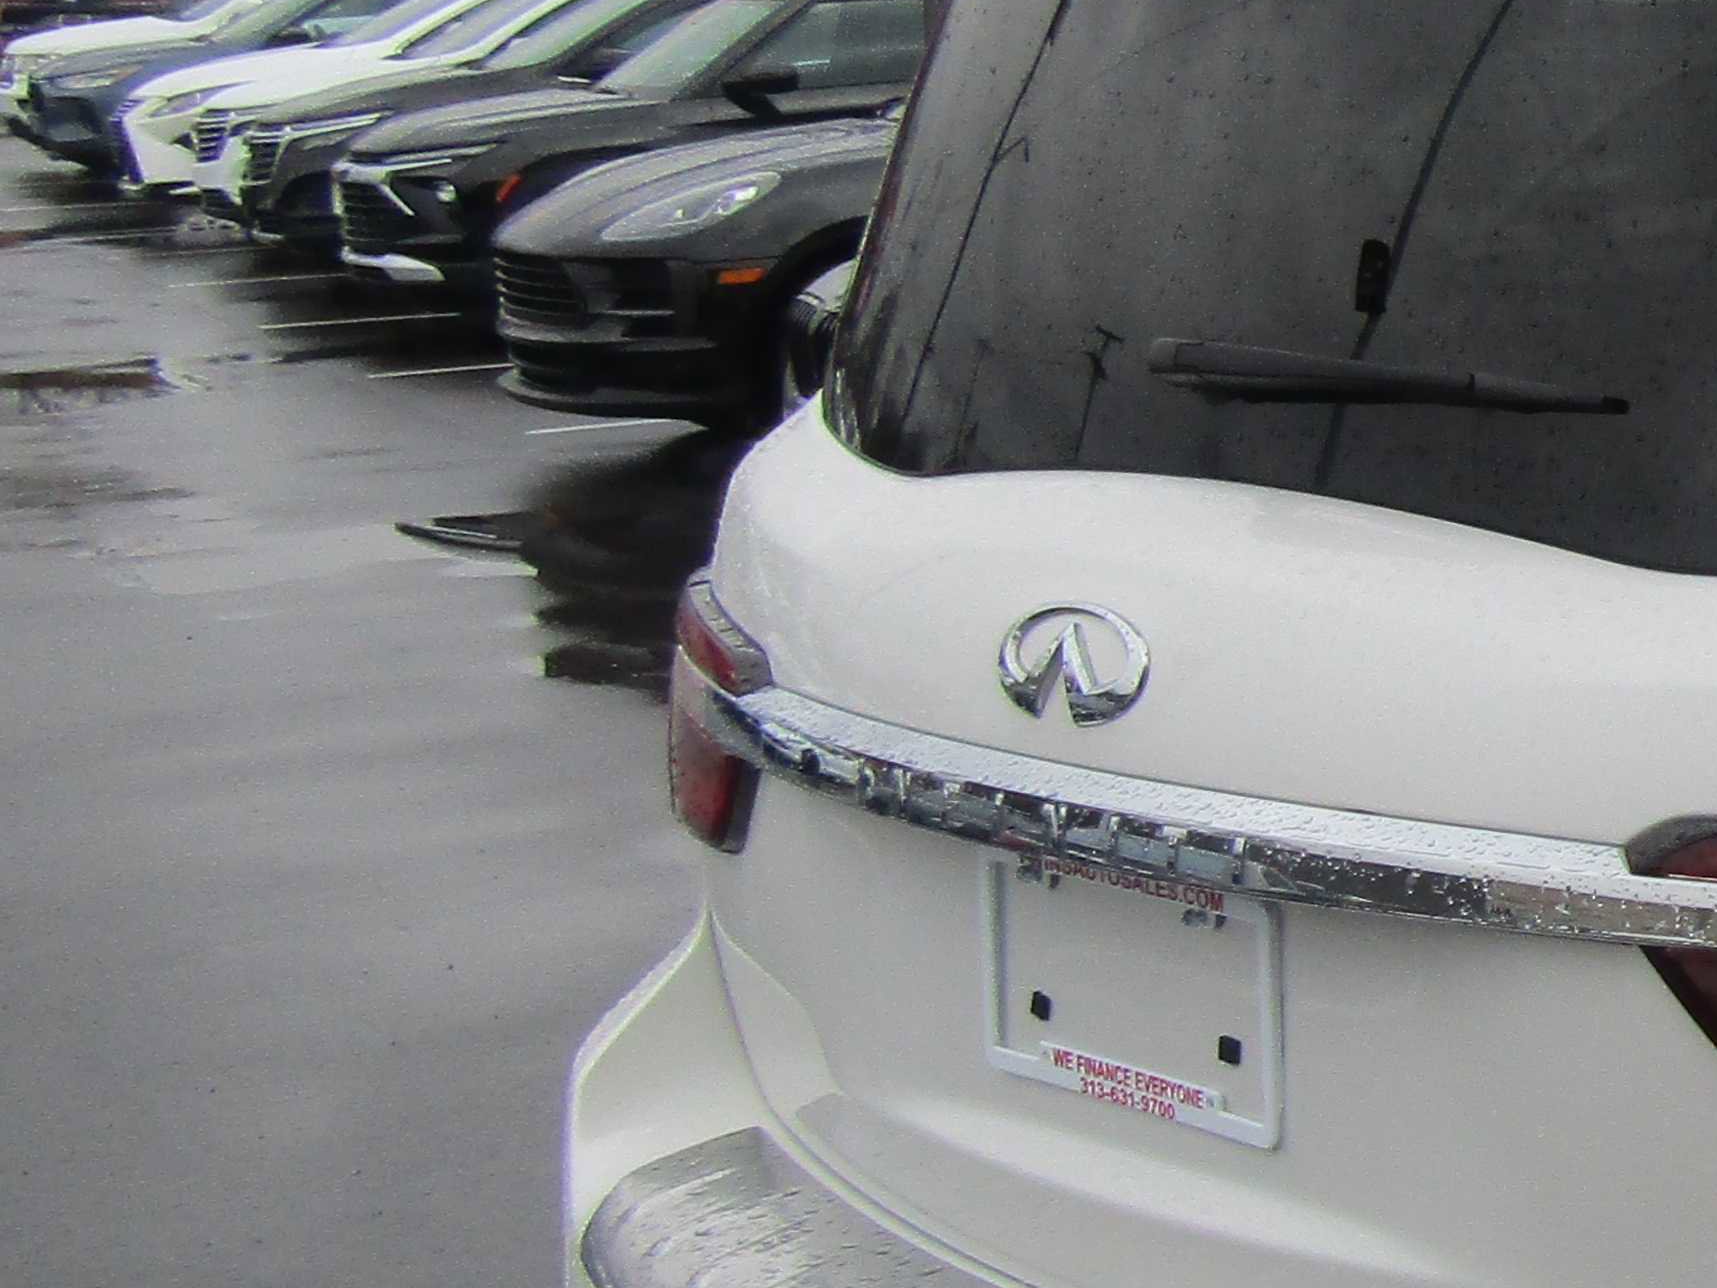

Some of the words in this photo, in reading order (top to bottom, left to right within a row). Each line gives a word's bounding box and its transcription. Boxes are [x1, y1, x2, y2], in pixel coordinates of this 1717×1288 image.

[1051, 1048, 1075, 1070] WE
[1076, 1055, 1132, 1087] FINANCE
[1134, 1070, 1205, 1109] EVERYONE
[1080, 1076, 1175, 1120] 313-631-9700
